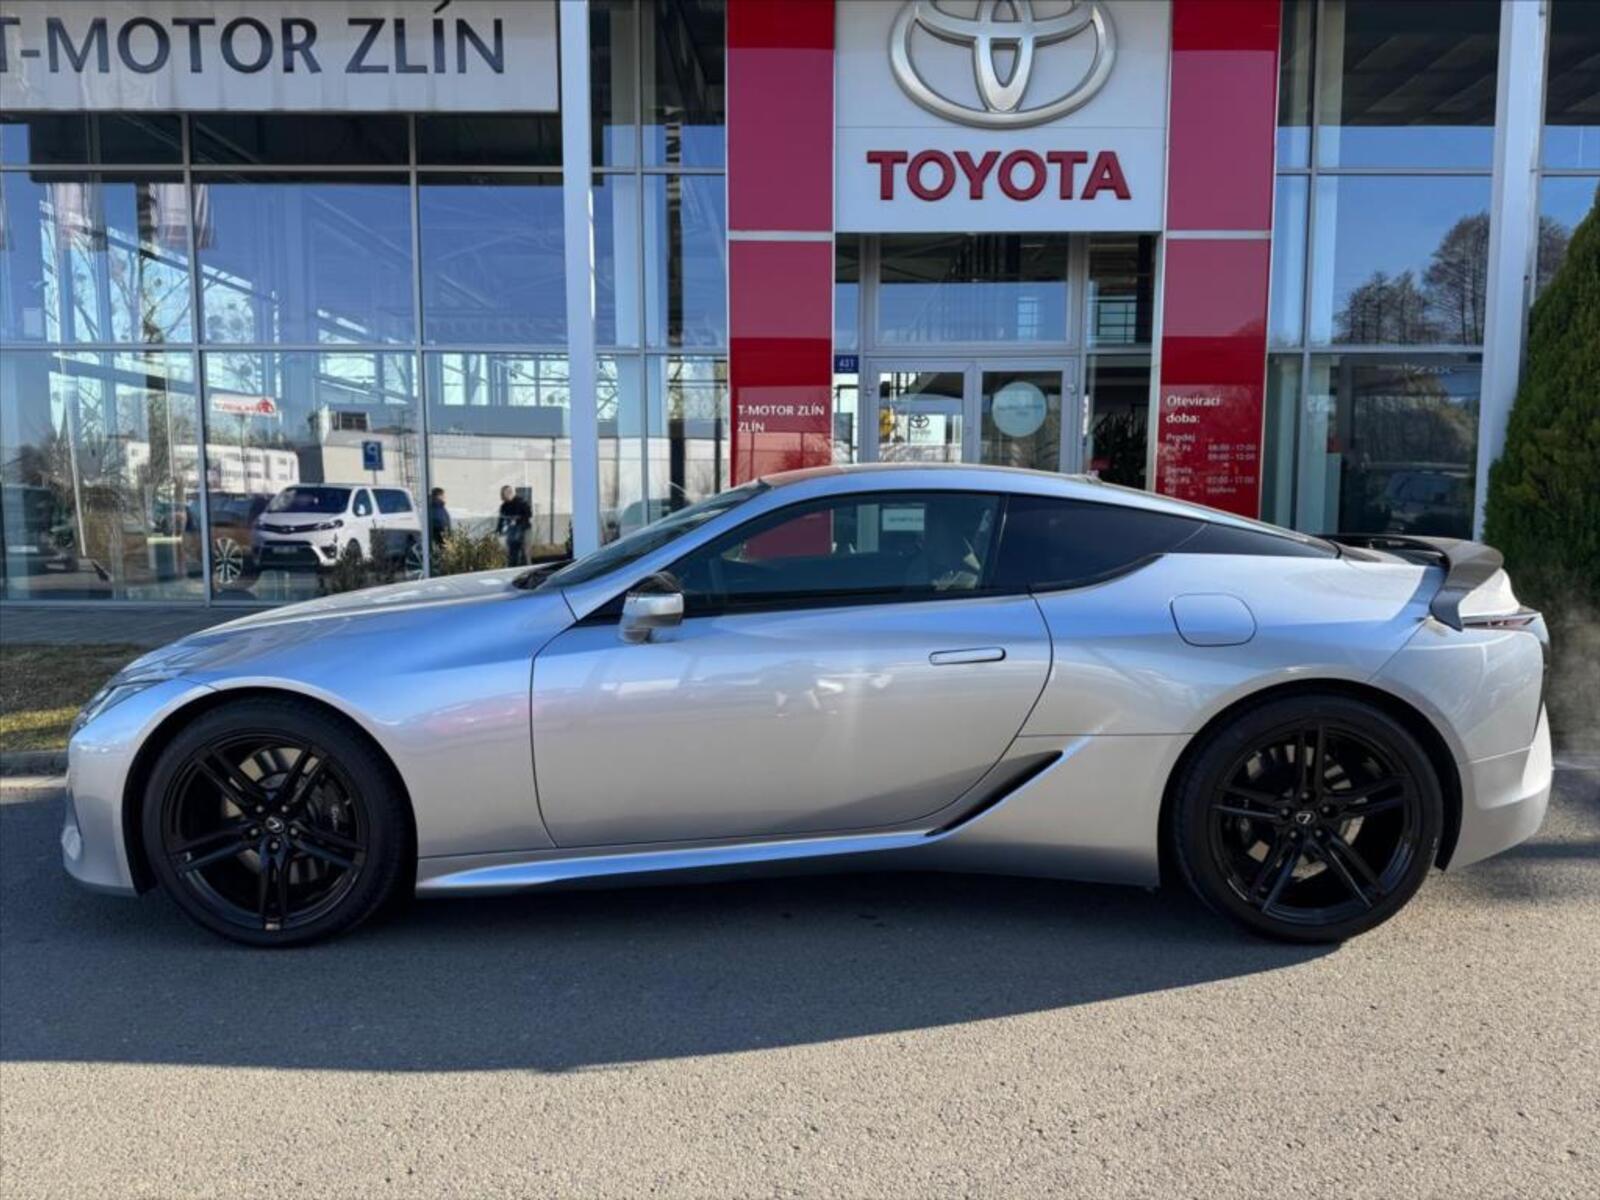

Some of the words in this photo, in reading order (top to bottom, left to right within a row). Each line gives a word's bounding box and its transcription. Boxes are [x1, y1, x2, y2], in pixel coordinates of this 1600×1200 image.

[0, 17, 323, 75] T-MOTOR
[345, 0, 506, 75] ZLÍN
[867, 149, 1132, 201] TOYOTA
[737, 404, 794, 416] T-MOTOR
[797, 402, 825, 416] ZLÍN
[1166, 412, 1200, 424] doba:
[737, 420, 765, 433] ZLÍN
